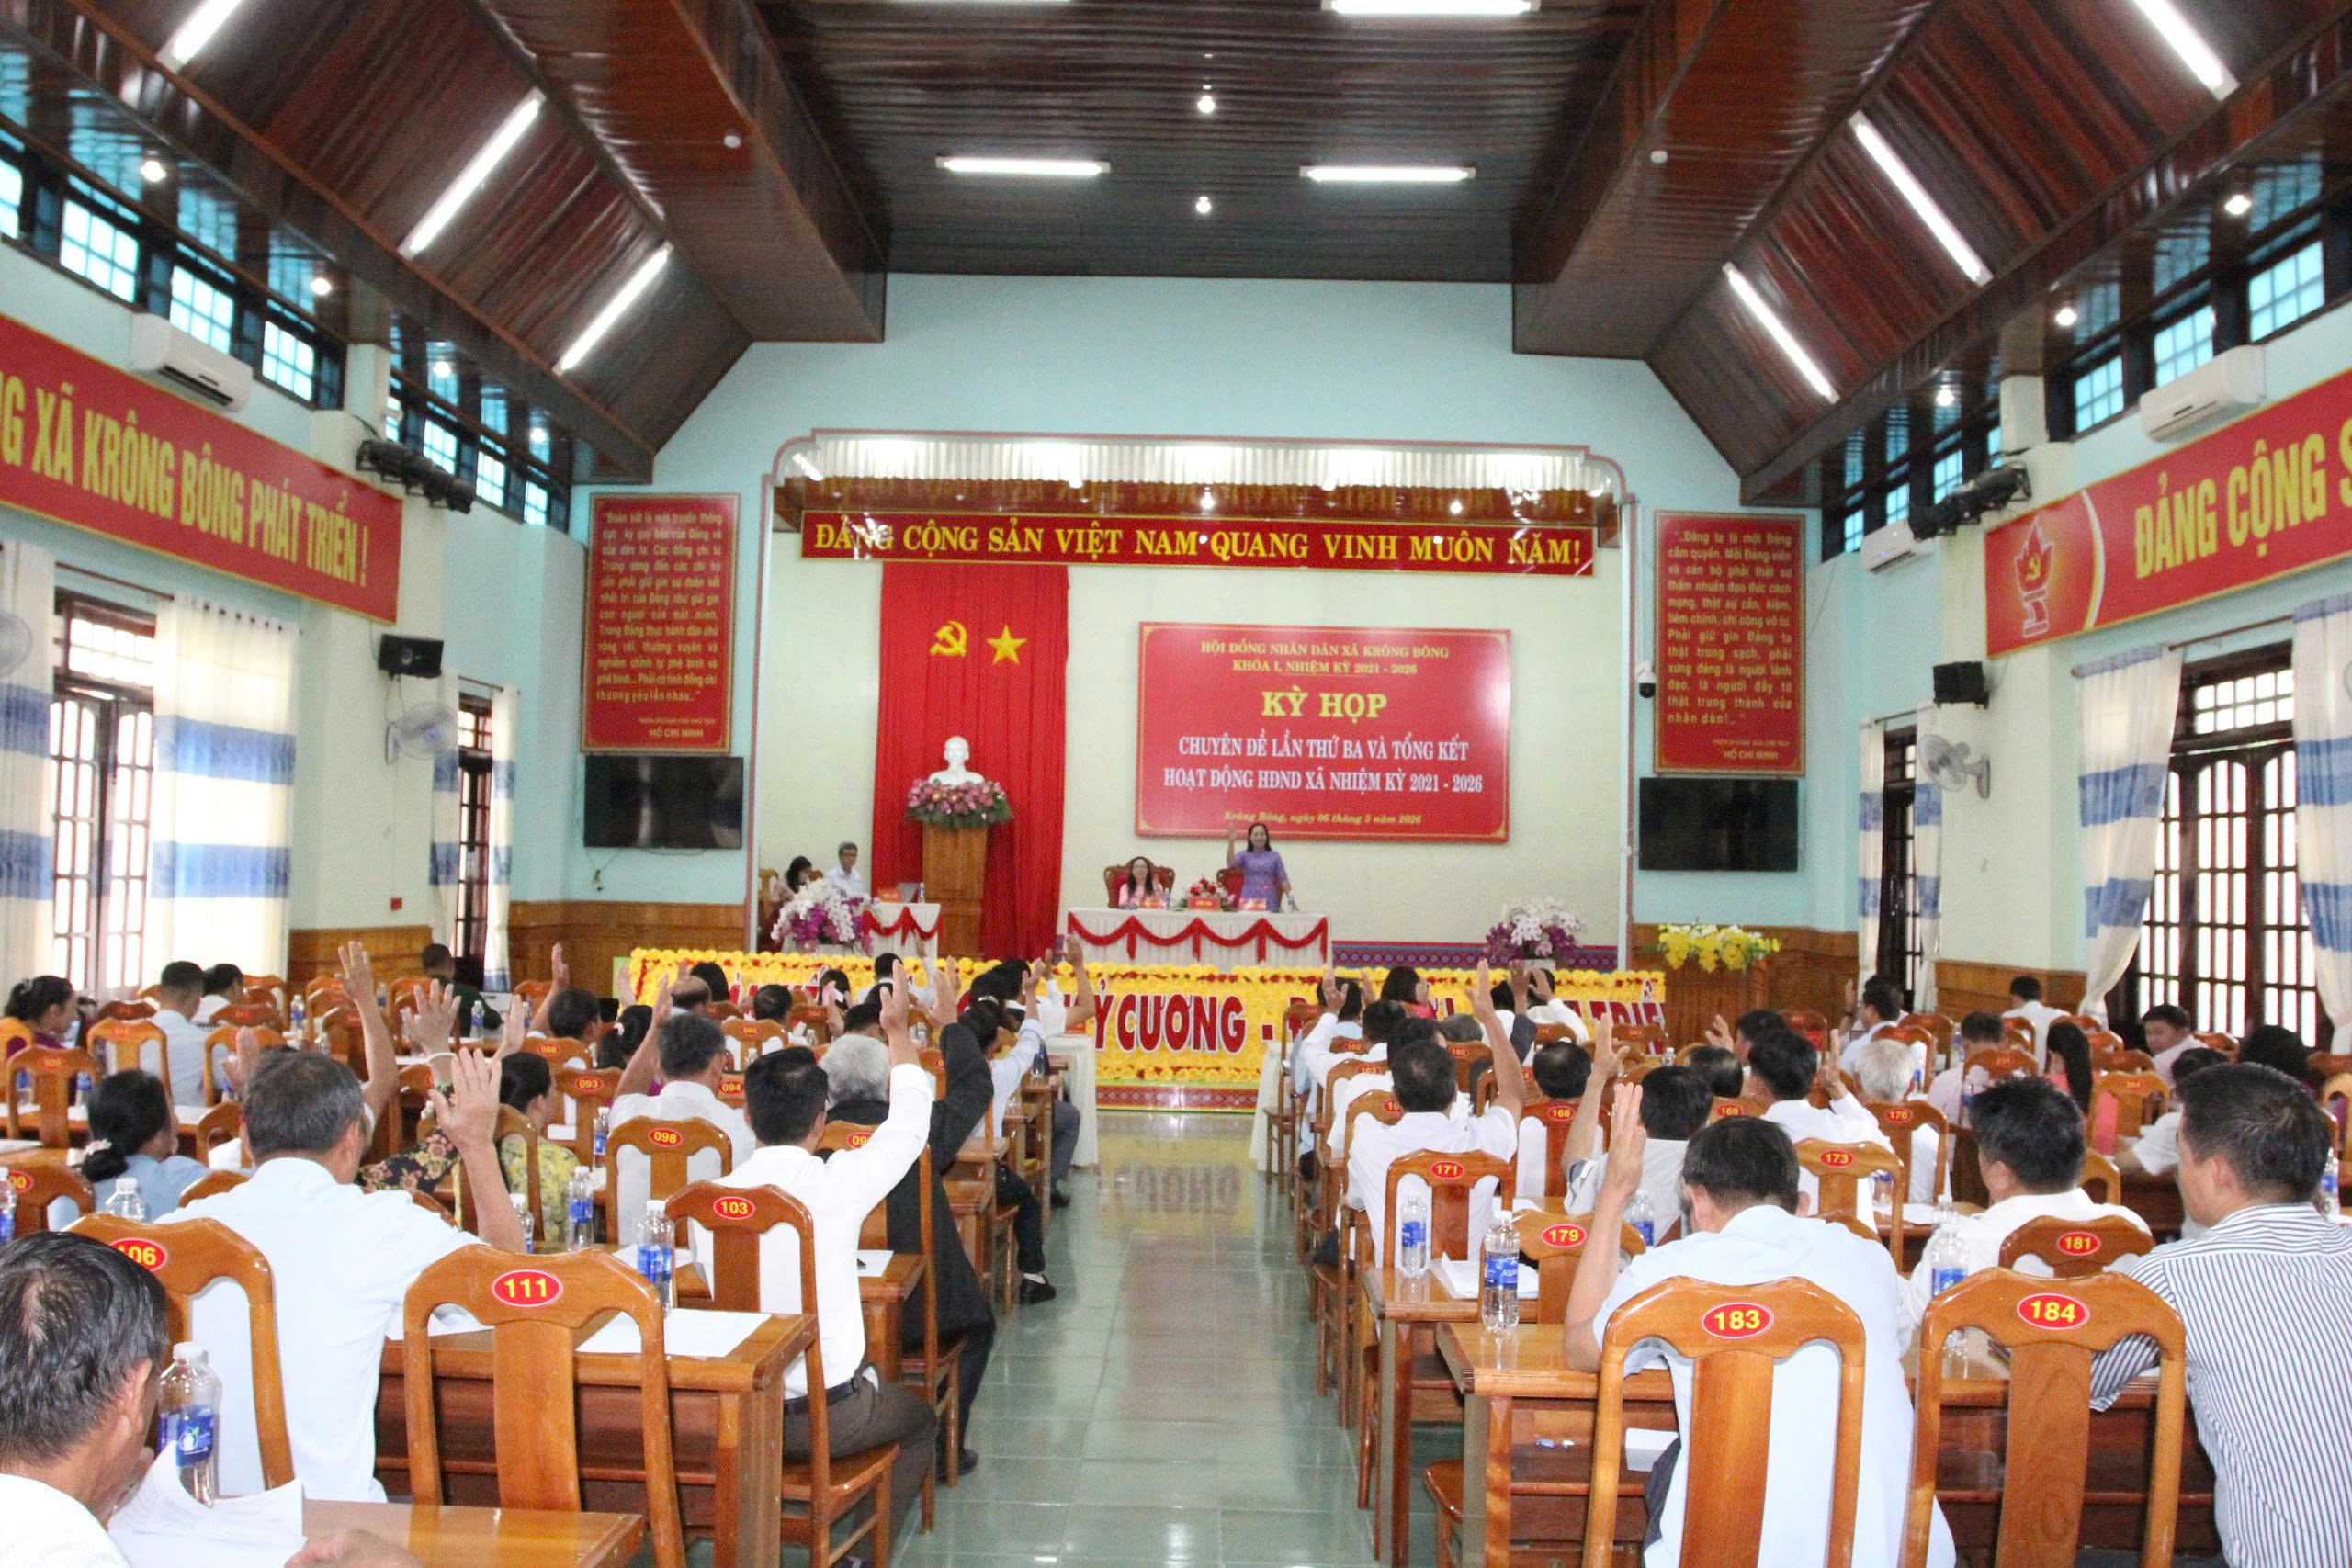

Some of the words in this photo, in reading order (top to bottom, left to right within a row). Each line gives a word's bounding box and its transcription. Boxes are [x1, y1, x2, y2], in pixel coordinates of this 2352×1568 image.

[0, 371, 25, 467] G
[31, 382, 74, 485] XÃ
[82, 409, 175, 519] KRÔNG
[181, 442, 243, 544] BÔNG
[249, 479, 301, 563] PHÁT
[306, 491, 357, 583] TRIỂN
[2134, 471, 2218, 580] ĐẢNG
[2227, 433, 2327, 558] CỘNG
[815, 515, 894, 551] ĐẢNG
[903, 520, 978, 558] CỘNG
[988, 517, 1043, 553] SẢN
[1056, 521, 1123, 559] VIỆT
[1136, 530, 1198, 556] NAM
[1210, 531, 1309, 561] QUANG
[1322, 534, 1398, 559] VINH
[1409, 529, 1494, 562] MUÔN
[1508, 533, 1581, 564] NĂM!
[1201, 639, 1225, 655] HỘI
[1229, 637, 1266, 654] ĐỒNG
[1271, 641, 1307, 655] NHÂN
[1311, 642, 1339, 656] DÂN
[1341, 643, 1359, 656] XÃ
[1363, 643, 1409, 657] KRÔNG
[1412, 644, 1449, 658] BÔNG
[1234, 658, 1270, 671] KHÓA
[1286, 660, 1329, 673] NHIỆM
[1333, 660, 1351, 673] KỲ
[1354, 663, 1380, 674] 2021
[1391, 664, 1418, 674] 2026
[1261, 685, 1308, 716] KỲ
[1319, 693, 1388, 724] HỌP
[1179, 732, 1242, 756] CHUYÊN
[1246, 728, 1267, 757] ĐỀ
[1272, 728, 1303, 758] LẦN
[1306, 734, 1340, 759] THỨ
[1343, 739, 1363, 759] BA
[1367, 735, 1388, 760] VÀ
[1392, 732, 1434, 760] TỔNG
[1438, 734, 1469, 761] KẾT
[1164, 768, 1207, 791] HOẠT
[1210, 764, 1253, 793] ĐỘNG
[1258, 770, 1302, 790] HĐND
[1306, 766, 1326, 790] XÃ
[1329, 766, 1381, 795] NHIỆM
[1385, 767, 1406, 792] KỲ
[1409, 774, 1439, 792] 2021
[1452, 774, 1483, 793] 2026
[1224, 811, 1256, 822] Krông
[1291, 814, 1315, 824] ngày
[1317, 813, 1329, 822] 06
[1332, 813, 1362, 824] tháng
[1374, 815, 1396, 824] năm
[1400, 815, 1421, 824] 2026
[1118, 991, 1247, 1052] CƯƠNG
[579, 1079, 597, 1089] 093
[722, 1084, 741, 1093] 094
[1553, 1109, 1570, 1118] 168
[653, 1132, 677, 1144] 098
[852, 1135, 868, 1146] 09
[1825, 1152, 1849, 1164] 173
[1435, 1165, 1459, 1176] 171
[720, 1201, 748, 1215] 103
[1549, 1229, 1579, 1242] 179
[2064, 1236, 2092, 1250] 181
[504, 1278, 549, 1299] 111
[2030, 1300, 2078, 1322] 184
[1714, 1309, 1761, 1330] 183
